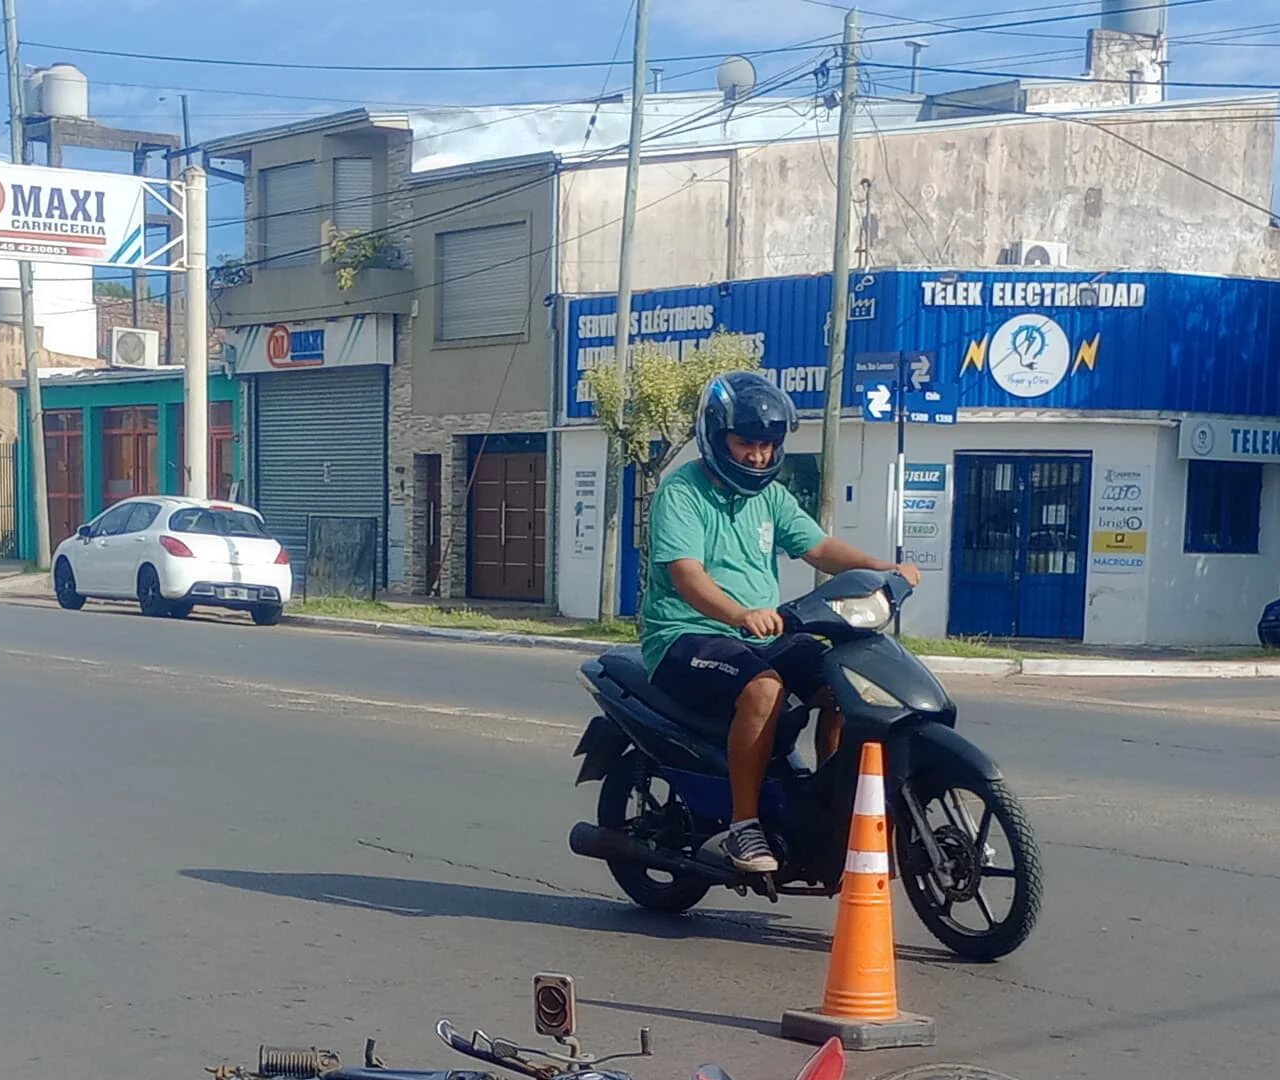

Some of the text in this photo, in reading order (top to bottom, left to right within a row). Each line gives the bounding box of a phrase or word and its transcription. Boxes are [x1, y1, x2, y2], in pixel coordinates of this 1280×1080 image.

[11, 184, 106, 223] MAXI
[11, 219, 106, 236] CARNICERIA
[922, 281, 983, 306] TELEK
[640, 305, 714, 334] ELÉCTRICOS
[780, 366, 829, 392] (CCTV
